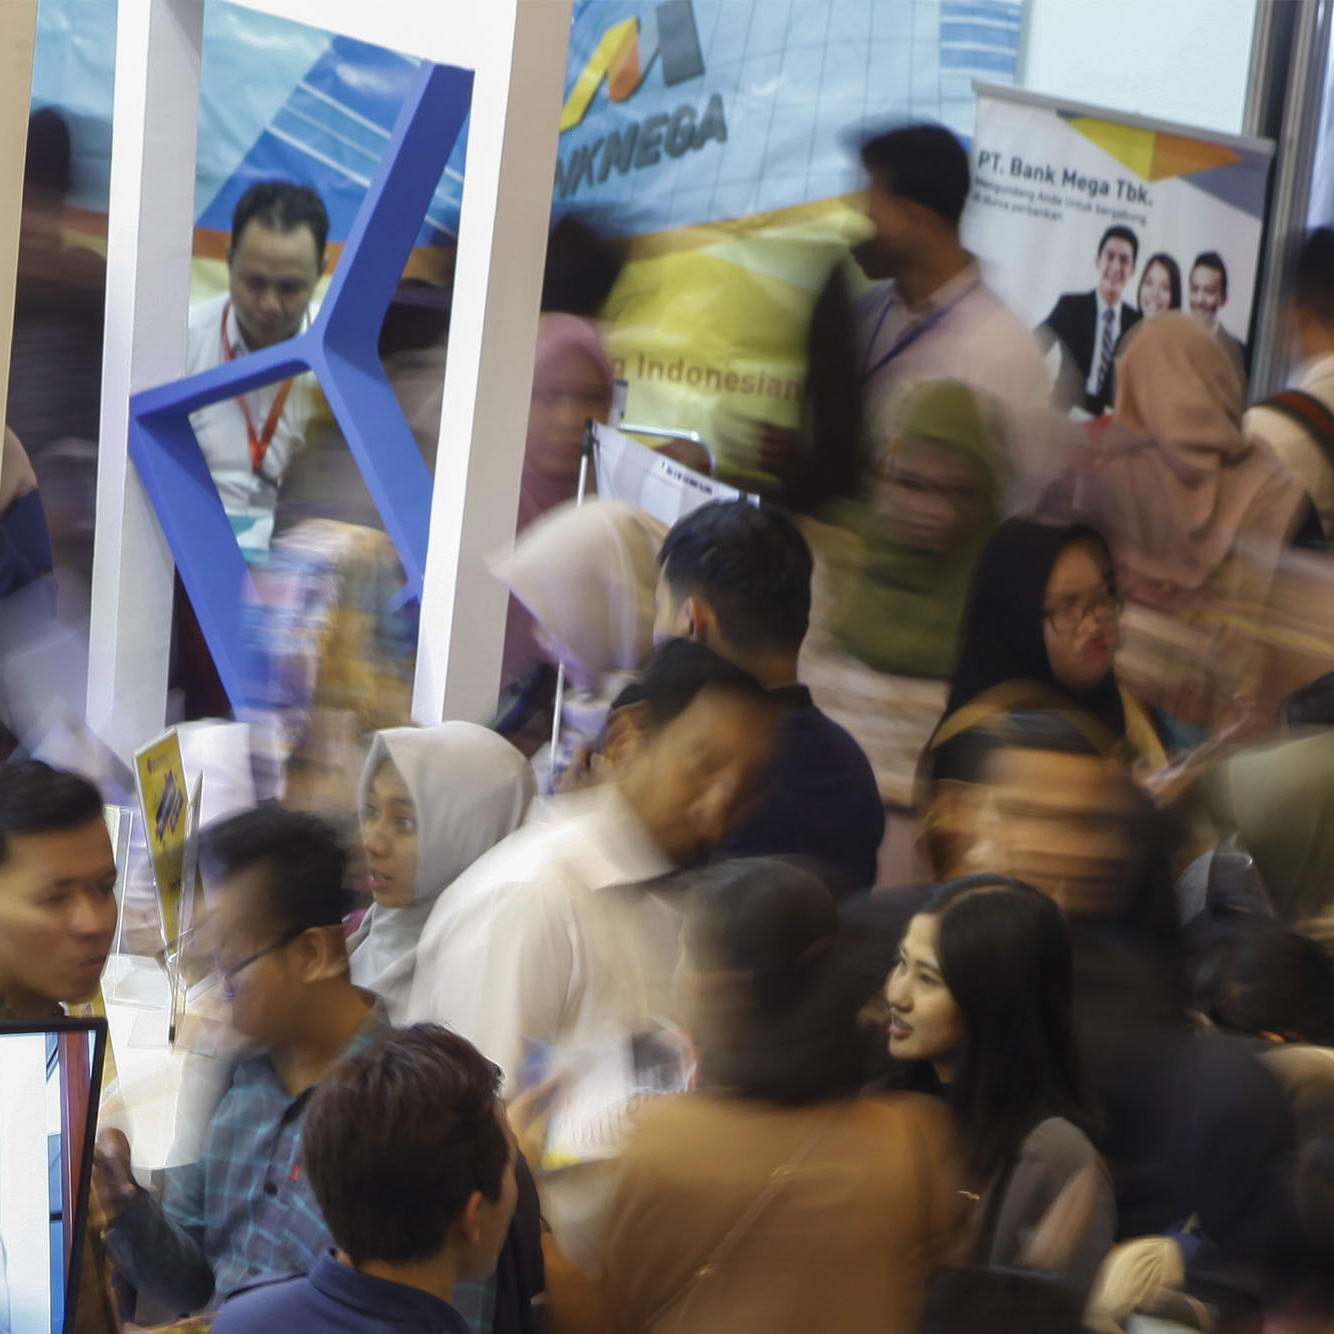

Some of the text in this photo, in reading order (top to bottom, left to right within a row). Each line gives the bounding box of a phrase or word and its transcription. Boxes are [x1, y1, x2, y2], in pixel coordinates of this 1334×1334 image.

[977, 150, 1153, 207] PT. Bank Mega Tbk.
